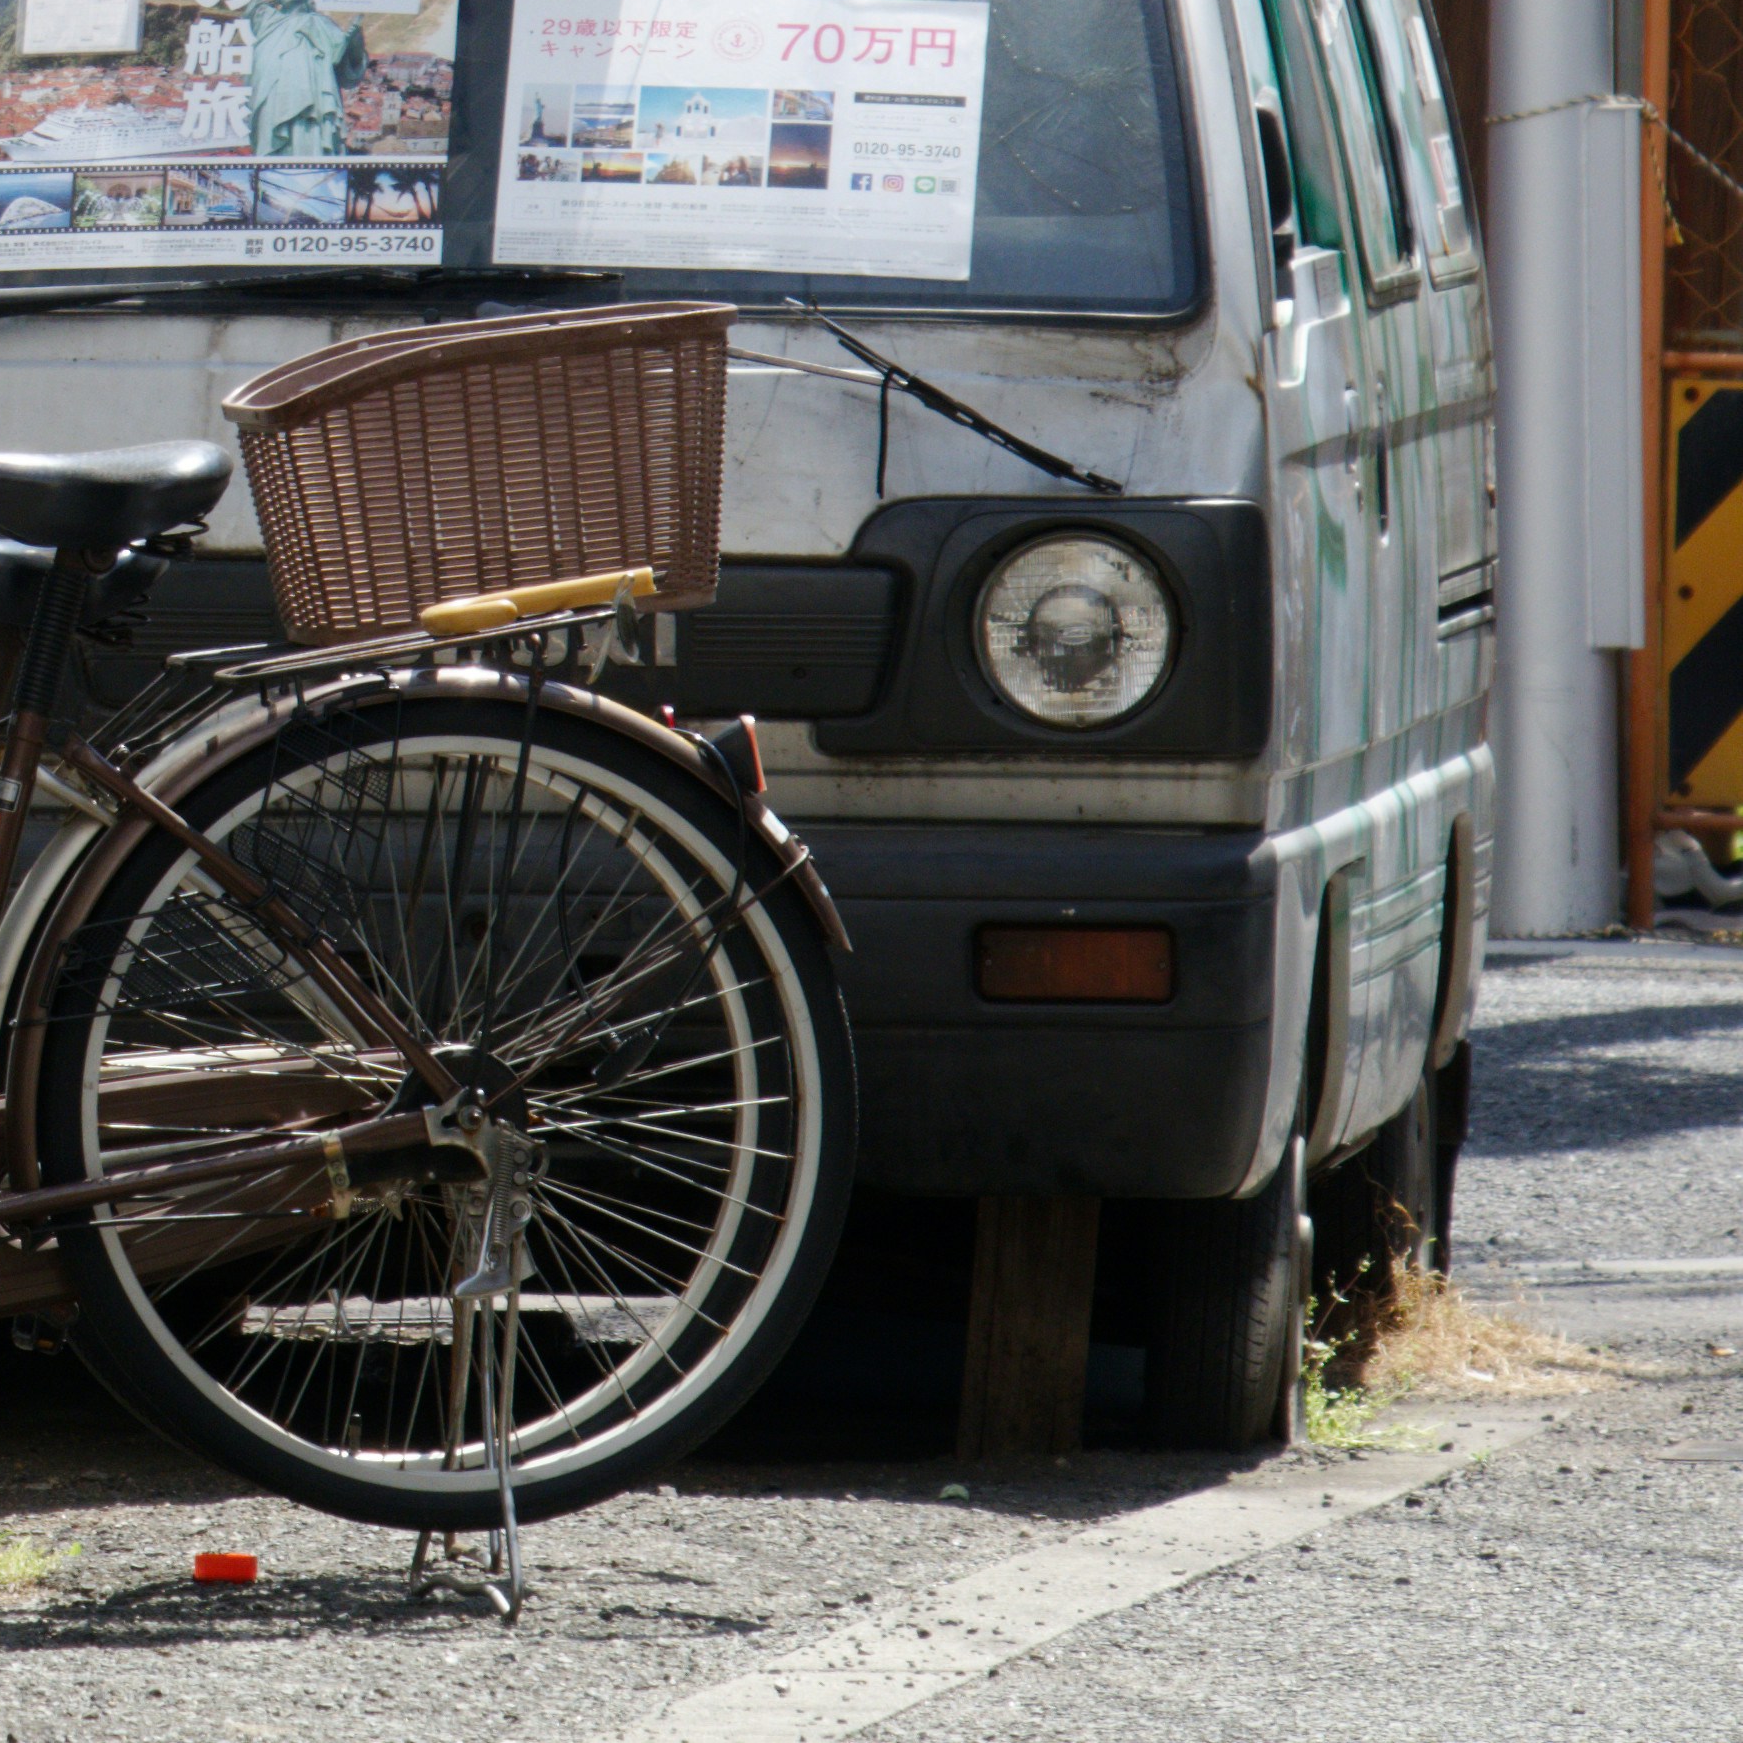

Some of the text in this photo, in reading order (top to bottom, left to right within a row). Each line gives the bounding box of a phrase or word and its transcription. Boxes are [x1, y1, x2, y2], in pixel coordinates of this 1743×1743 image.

[541, 18, 699, 40] 29歳以下限定
[540, 40, 697, 60] キャンペーン
[775, 21, 958, 69] 70万円
[853, 142, 962, 159] 0120-95-3740
[272, 236, 436, 253] 0120-95-3740
